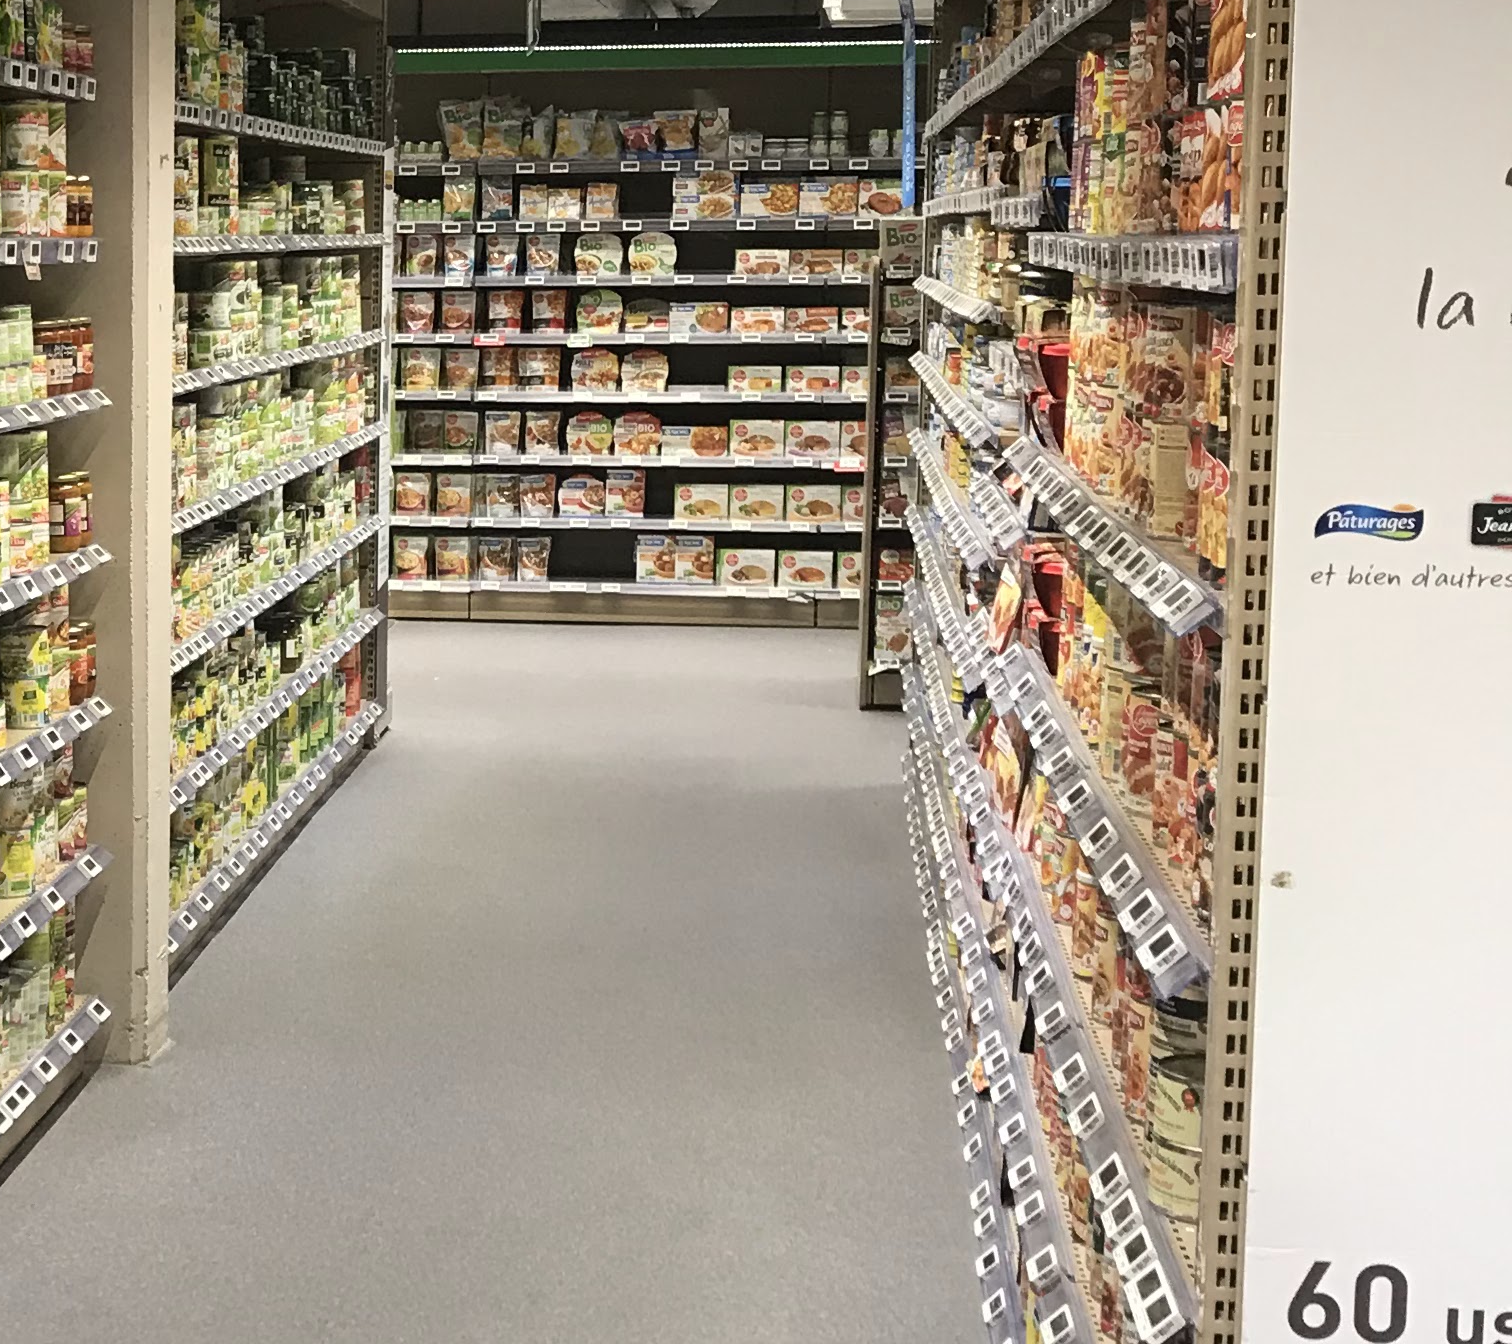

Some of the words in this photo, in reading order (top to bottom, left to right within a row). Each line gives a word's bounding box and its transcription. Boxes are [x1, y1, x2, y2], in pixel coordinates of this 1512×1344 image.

[1416, 267, 1474, 330] la
[1310, 563, 1336, 587] et
[1348, 563, 1401, 587] bien
[1411, 563, 1512, 589] d'autres
[1287, 1260, 1408, 1344] 60
